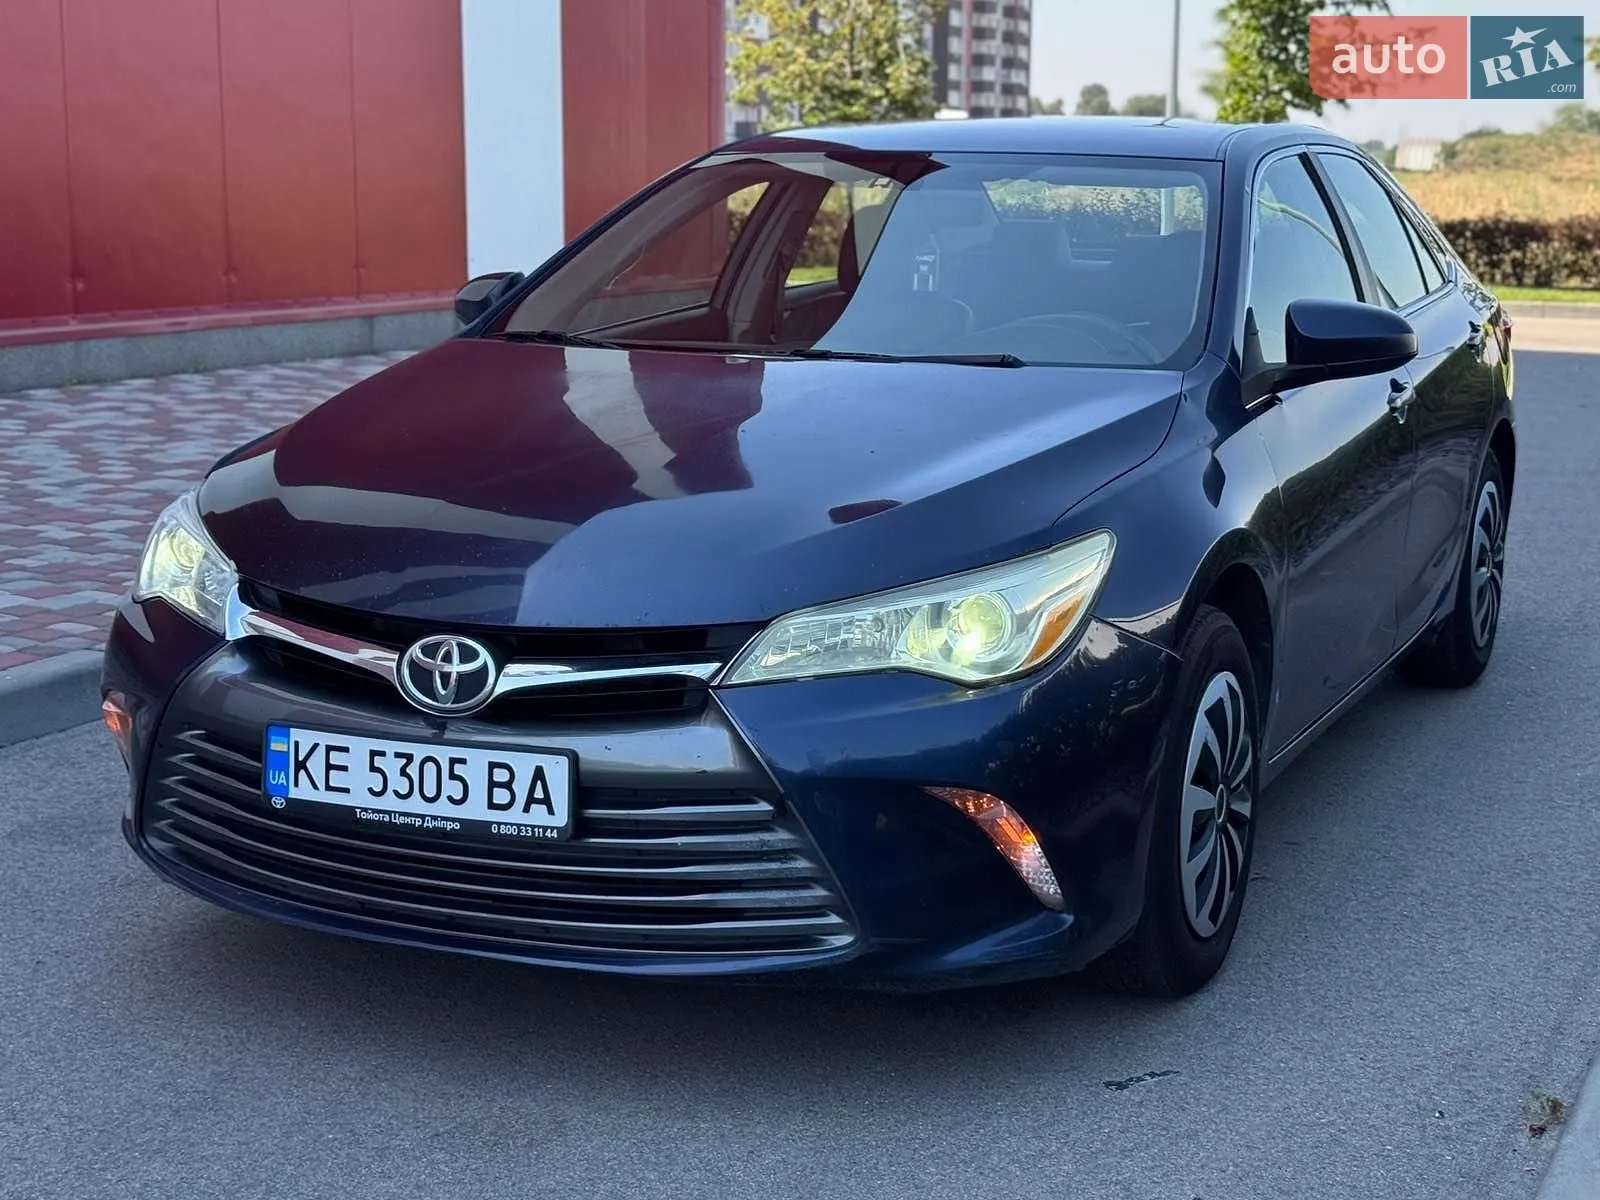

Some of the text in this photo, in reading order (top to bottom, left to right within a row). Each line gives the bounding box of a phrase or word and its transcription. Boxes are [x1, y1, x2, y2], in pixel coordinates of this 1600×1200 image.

[269, 769, 287, 786] UA
[292, 739, 556, 816] KE 5305 BA
[355, 808, 461, 831] Тойота Центр Дніпро
[491, 824, 558, 839] 0 800 33 11 44
